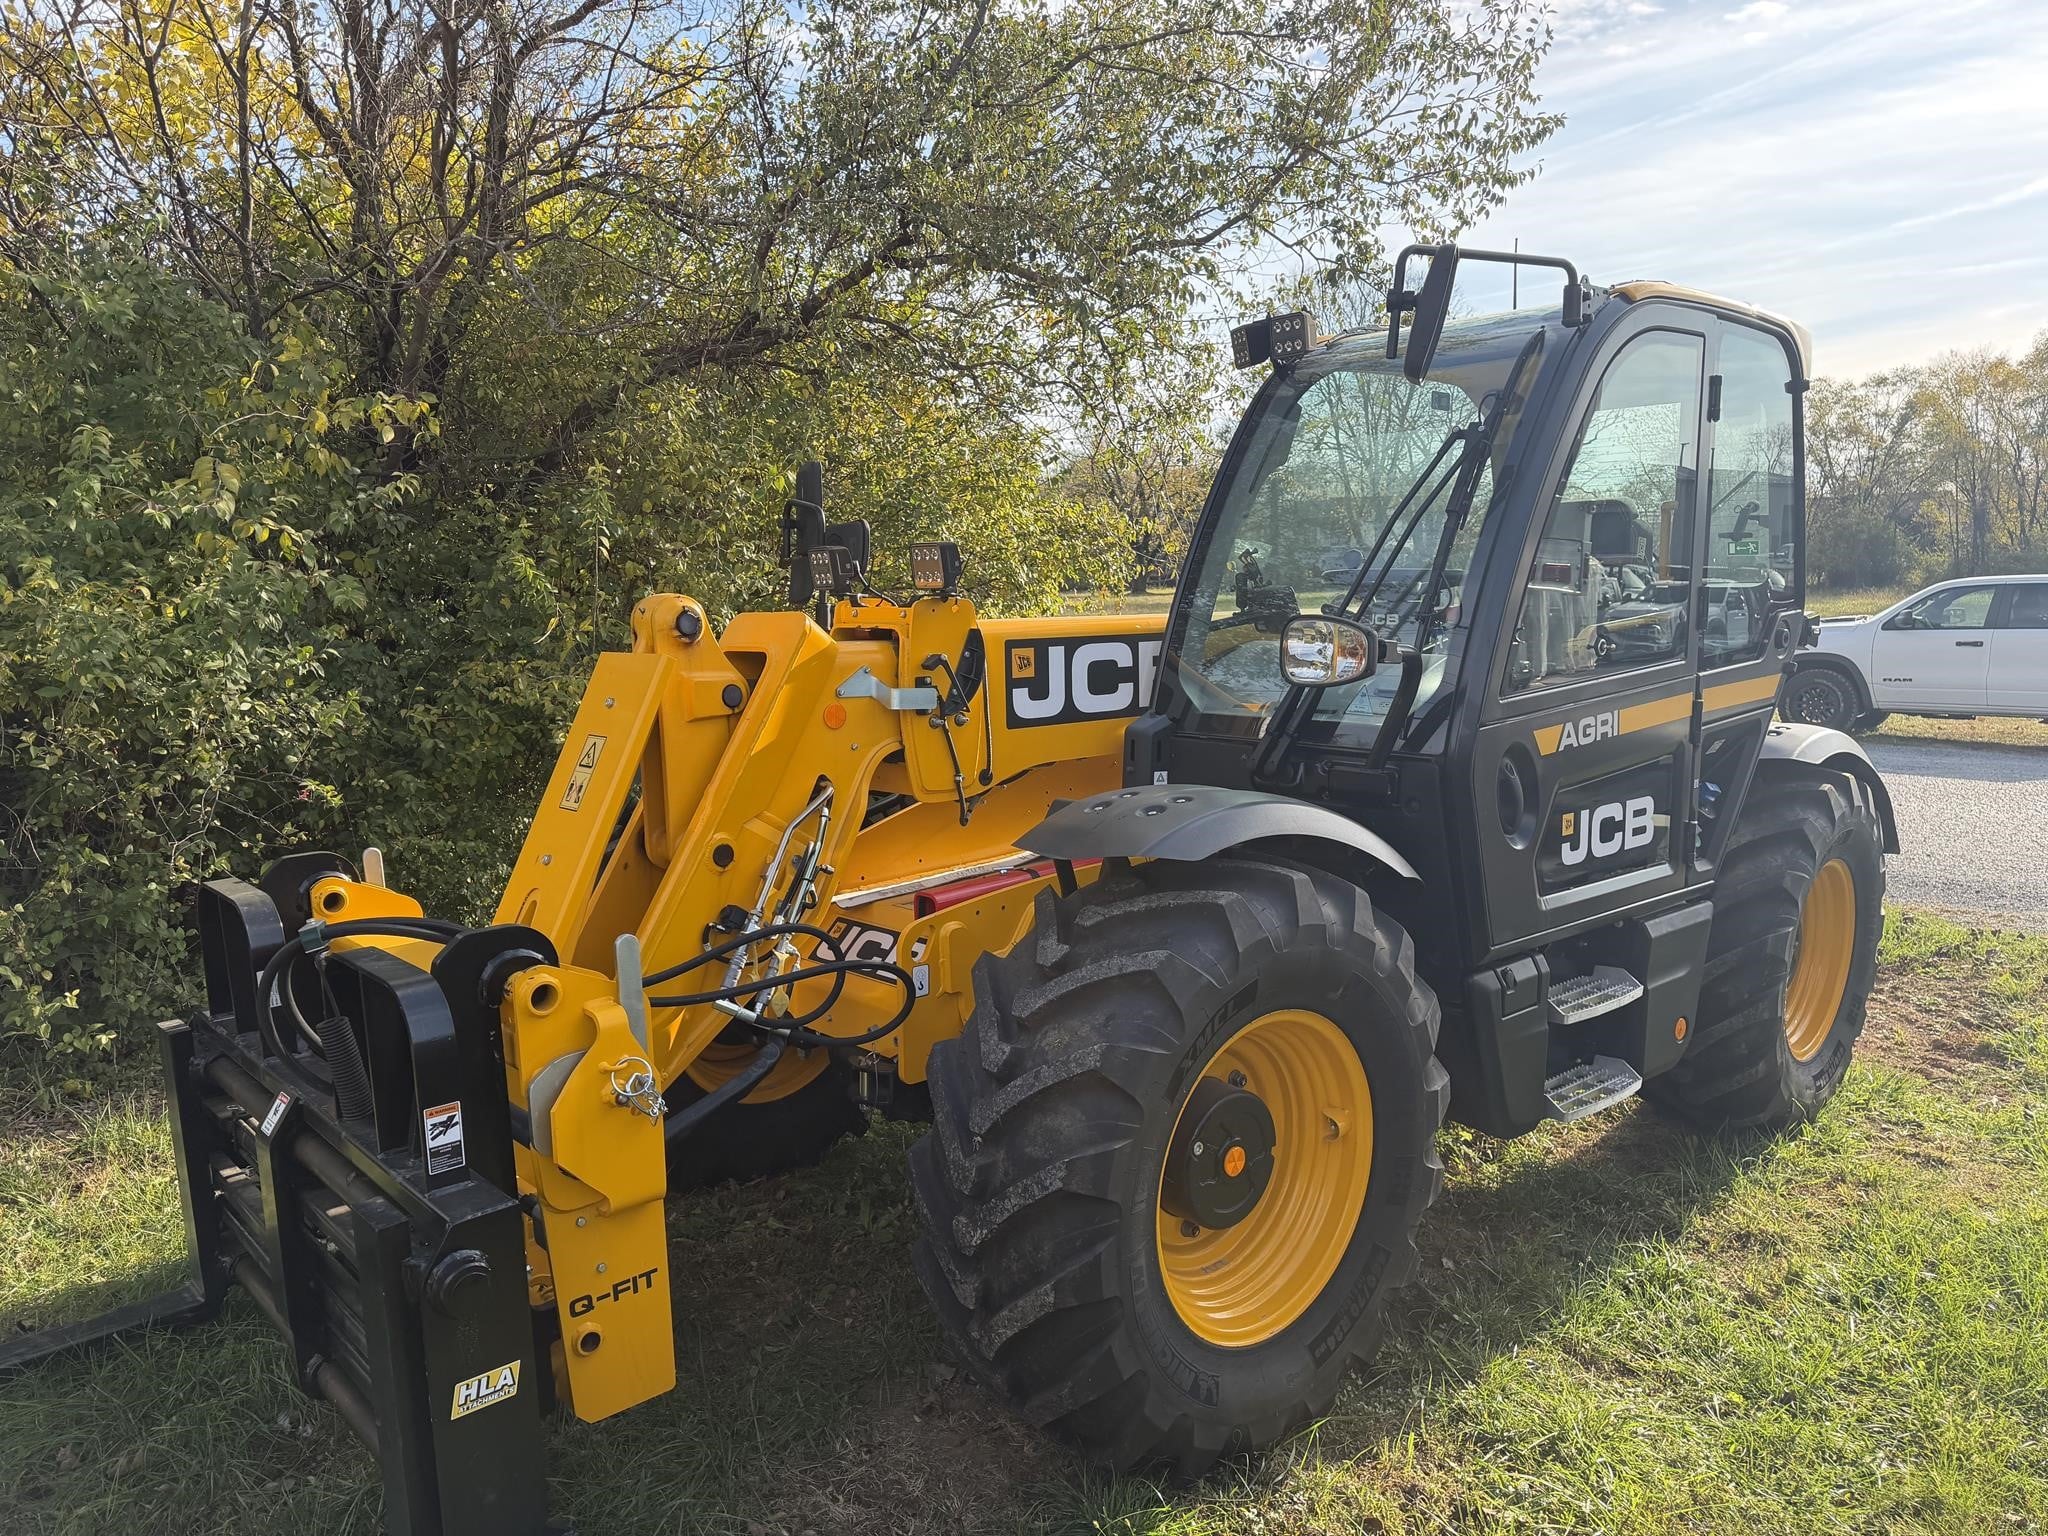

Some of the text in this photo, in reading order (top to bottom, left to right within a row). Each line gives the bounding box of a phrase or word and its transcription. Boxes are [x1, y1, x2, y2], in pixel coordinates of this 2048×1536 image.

[1558, 709, 1618, 752] AGRI
[1561, 795, 1655, 866] JCB
[569, 1268, 658, 1318] Q-FIT
[457, 1367, 516, 1406] HLA
